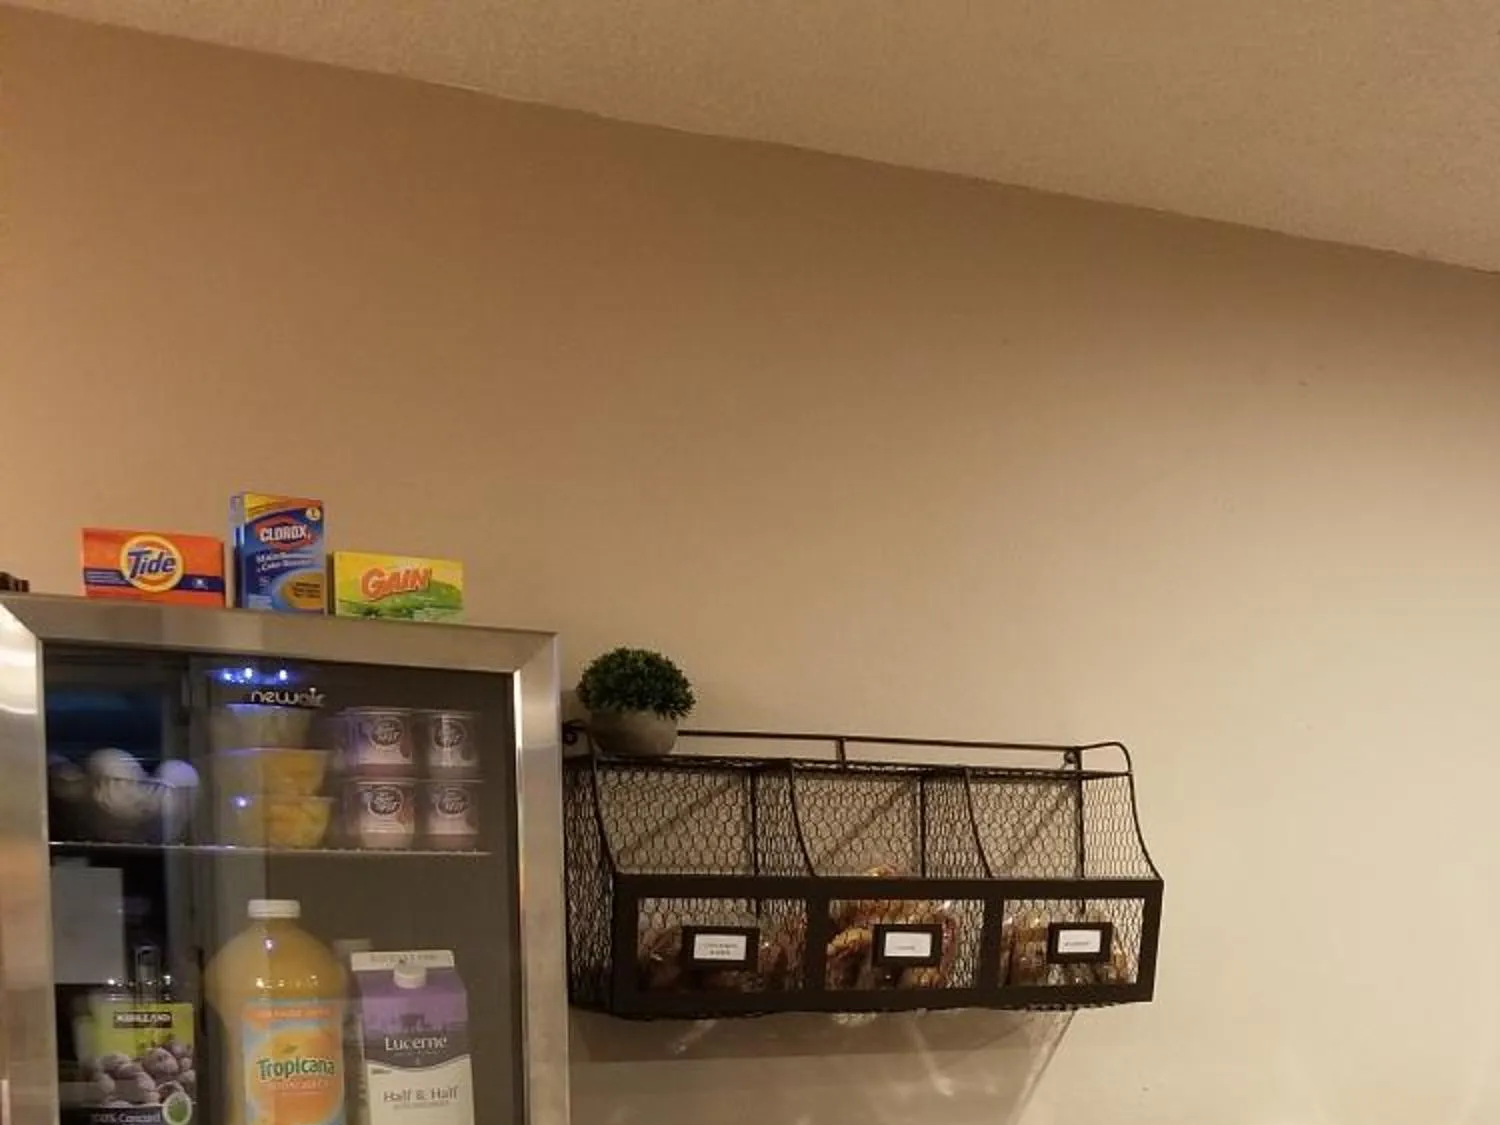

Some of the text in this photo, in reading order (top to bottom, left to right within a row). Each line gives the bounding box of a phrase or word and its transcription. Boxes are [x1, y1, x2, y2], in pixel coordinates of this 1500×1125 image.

[259, 524, 306, 543] CLOROX
[127, 550, 177, 579] Tide
[360, 566, 431, 602] GAIN
[250, 687, 325, 704] newair
[384, 1035, 447, 1051] Lucerne
[256, 1057, 335, 1080] Tropicana
[383, 1088, 412, 1103] Half
[431, 1085, 458, 1100] Half
